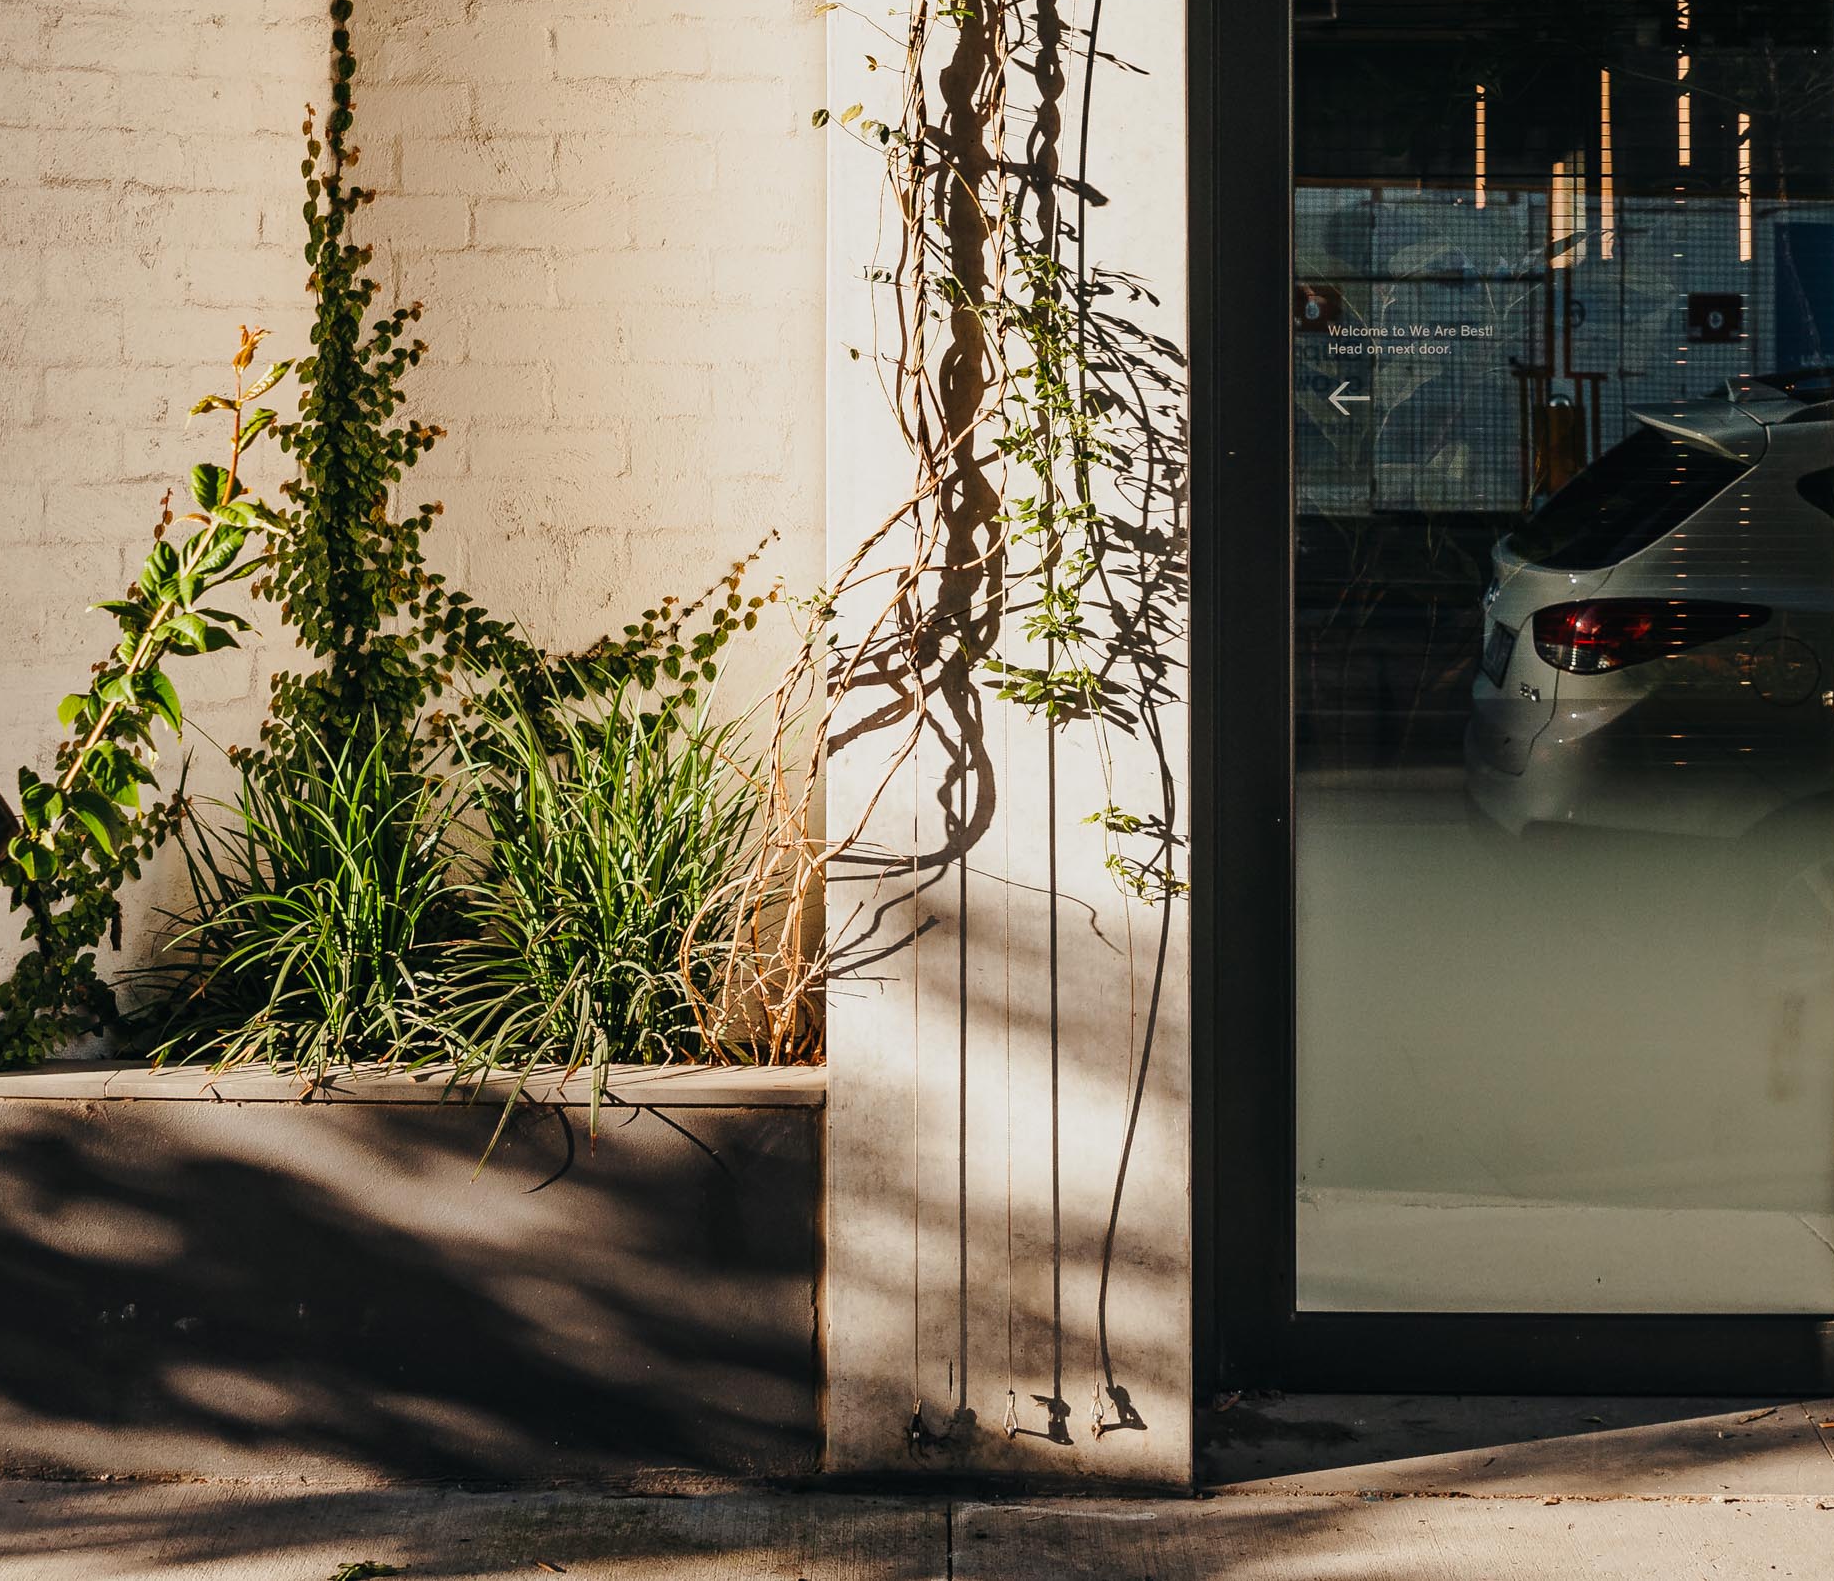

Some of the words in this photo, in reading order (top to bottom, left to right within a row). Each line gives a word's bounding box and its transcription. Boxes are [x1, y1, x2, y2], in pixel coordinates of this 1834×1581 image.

[1328, 325, 1388, 337] Welcome
[1392, 326, 1405, 337] to
[1409, 325, 1430, 337] We
[1434, 325, 1456, 337] Are
[1461, 325, 1493, 337] Best!
[1328, 343, 1362, 355] Head
[1367, 345, 1383, 355] on
[1388, 343, 1416, 355] next
[1419, 343, 1452, 355] door.
